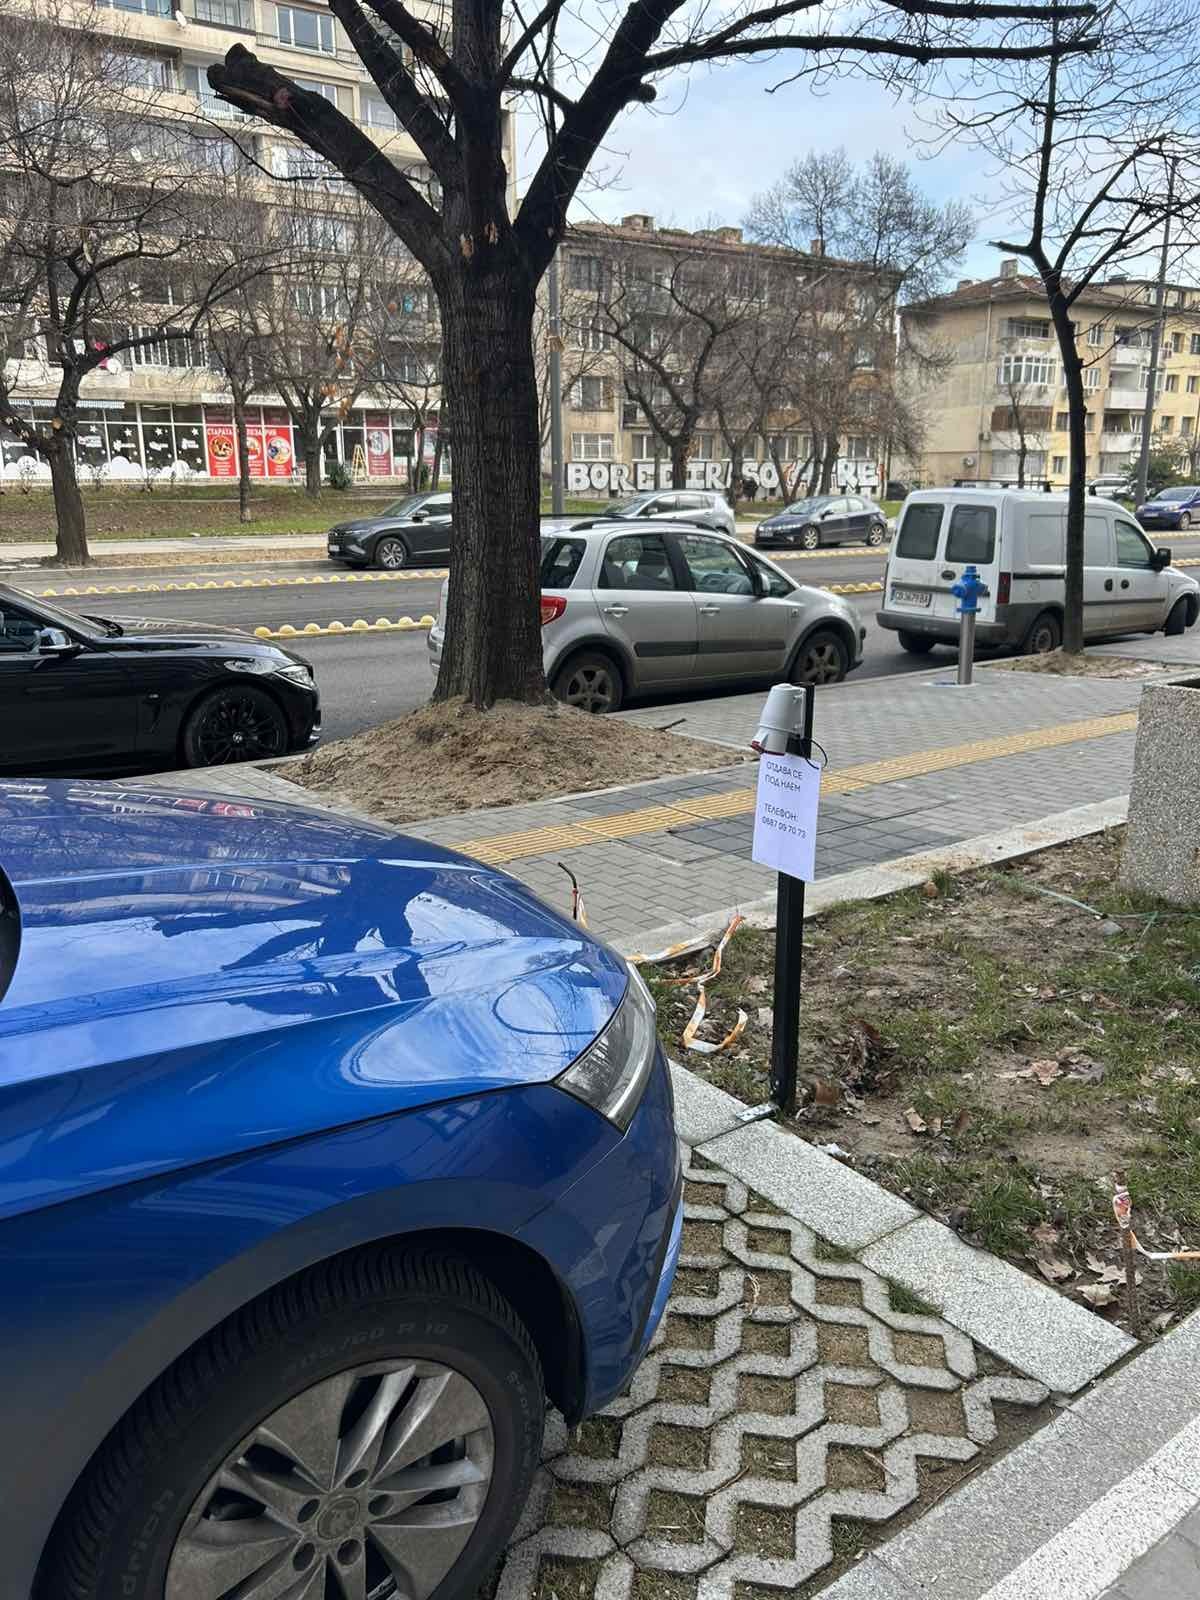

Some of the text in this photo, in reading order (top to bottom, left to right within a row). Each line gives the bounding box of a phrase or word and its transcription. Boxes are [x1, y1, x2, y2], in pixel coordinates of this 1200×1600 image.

[766, 761, 803, 781] ОТДАВА СЕ
[765, 775, 801, 792] ПОД НАЕМ
[764, 803, 798, 821] ТЕЛЕФОН:
